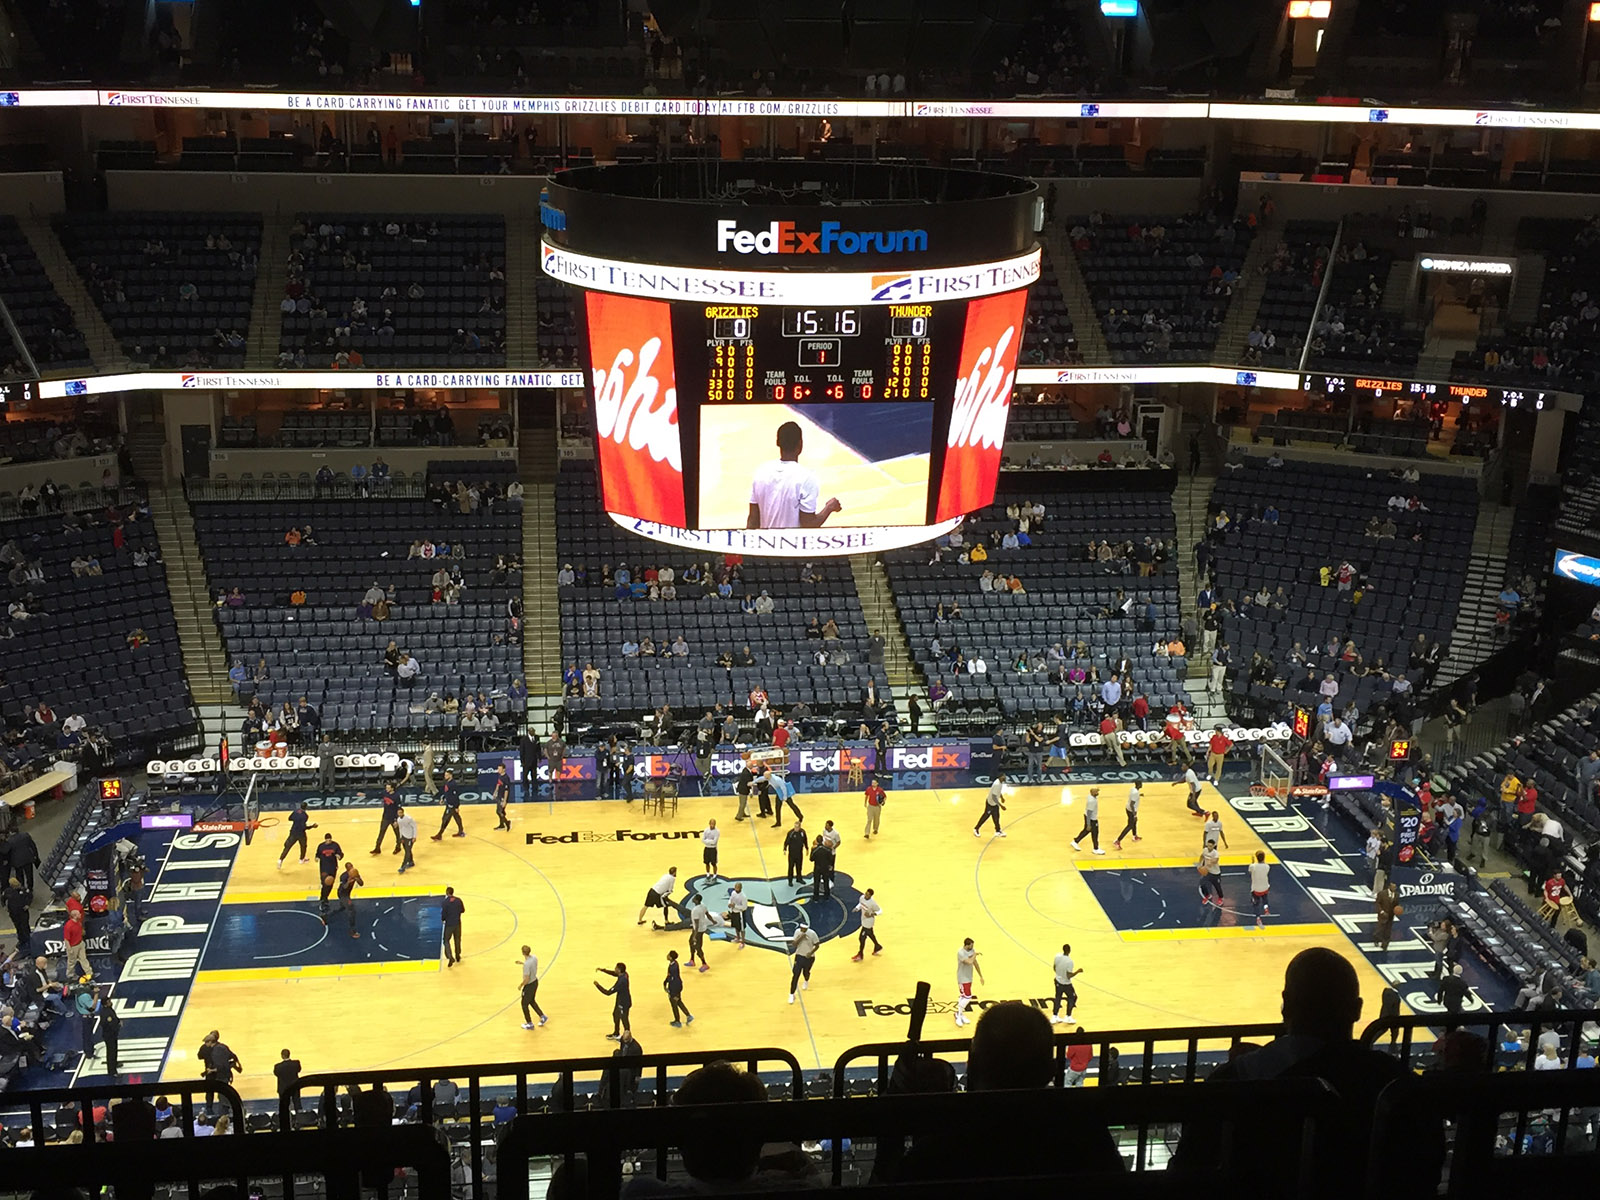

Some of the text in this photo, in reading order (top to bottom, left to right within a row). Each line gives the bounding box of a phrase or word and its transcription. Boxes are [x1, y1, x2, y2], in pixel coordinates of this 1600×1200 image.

[120, 94, 200, 105] FIRST TENNESSEE
[287, 96, 300, 107] BE
[305, 97, 312, 107] A
[458, 99, 477, 110] GET
[482, 99, 508, 111] YOUR
[513, 100, 560, 111] MEMPHIS
[565, 101, 617, 112] GRIZZLIES
[621, 101, 650, 112] DEBIT
[654, 102, 681, 113] CARD
[685, 102, 717, 113] TODAY
[721, 103, 733, 113] AT
[737, 103, 839, 114] FTB.COM/GRIZZLIES
[717, 219, 928, 254] FedExForum
[557, 255, 777, 298] FIRST TENNESSEE
[918, 273, 985, 295] FIRST
[705, 306, 759, 318] GRIZZLIES
[889, 305, 932, 317] THUNDER
[796, 310, 856, 334] 15:16
[912, 318, 925, 336] 0
[734, 319, 746, 337] 0
[706, 339, 724, 347] PLYR
[807, 342, 833, 350] PERIOD
[716, 346, 754, 356] 5 0 0
[893, 345, 930, 354] 0 0 0
[716, 357, 753, 367] 9 0 0
[893, 356, 929, 365] 2 0 0
[712, 368, 753, 378] 11 0 0
[892, 366, 929, 376] 9 0 0
[196, 376, 223, 387] FIRST
[376, 374, 390, 386] BE
[395, 375, 402, 386] A
[408, 374, 500, 387] CARD-CARRYING
[561, 374, 581, 386] GET
[709, 379, 753, 389] 33 0 0
[852, 377, 874, 385] FOULS
[888, 377, 928, 387] 12 0 0
[1356, 378, 1403, 391] GRIZZLIES
[708, 390, 752, 400] 50 0 0
[775, 386, 784, 400] 0
[794, 386, 802, 400] 6
[835, 385, 843, 399] 6
[862, 385, 871, 399] 0
[884, 388, 928, 398] 21 0 0
[1375, 388, 1382, 397] 0
[1450, 386, 1488, 398] THUNDER
[1463, 395, 1469, 404] 0
[499, 450, 511, 458] 106
[563, 450, 574, 458] 105
[722, 528, 875, 551] TENNESSEE
[237, 758, 247, 769] G
[253, 758, 262, 769] G
[269, 758, 279, 769] G
[285, 758, 295, 768] G
[303, 757, 312, 767] G
[335, 756, 344, 766] G
[351, 755, 361, 765] G
[368, 755, 377, 765] G
[799, 748, 869, 774] FedEx
[893, 746, 958, 770] FedEx
[151, 760, 161, 772] G
[169, 760, 179, 772] G
[187, 760, 196, 771] G
[201, 760, 211, 770] G
[105, 788, 118, 797] 24
[1400, 816, 1418, 828] $20
[526, 829, 705, 844] FedExForum
[1399, 882, 1455, 898] SPALDING
[77, 832, 240, 1079] MEMPHIS
